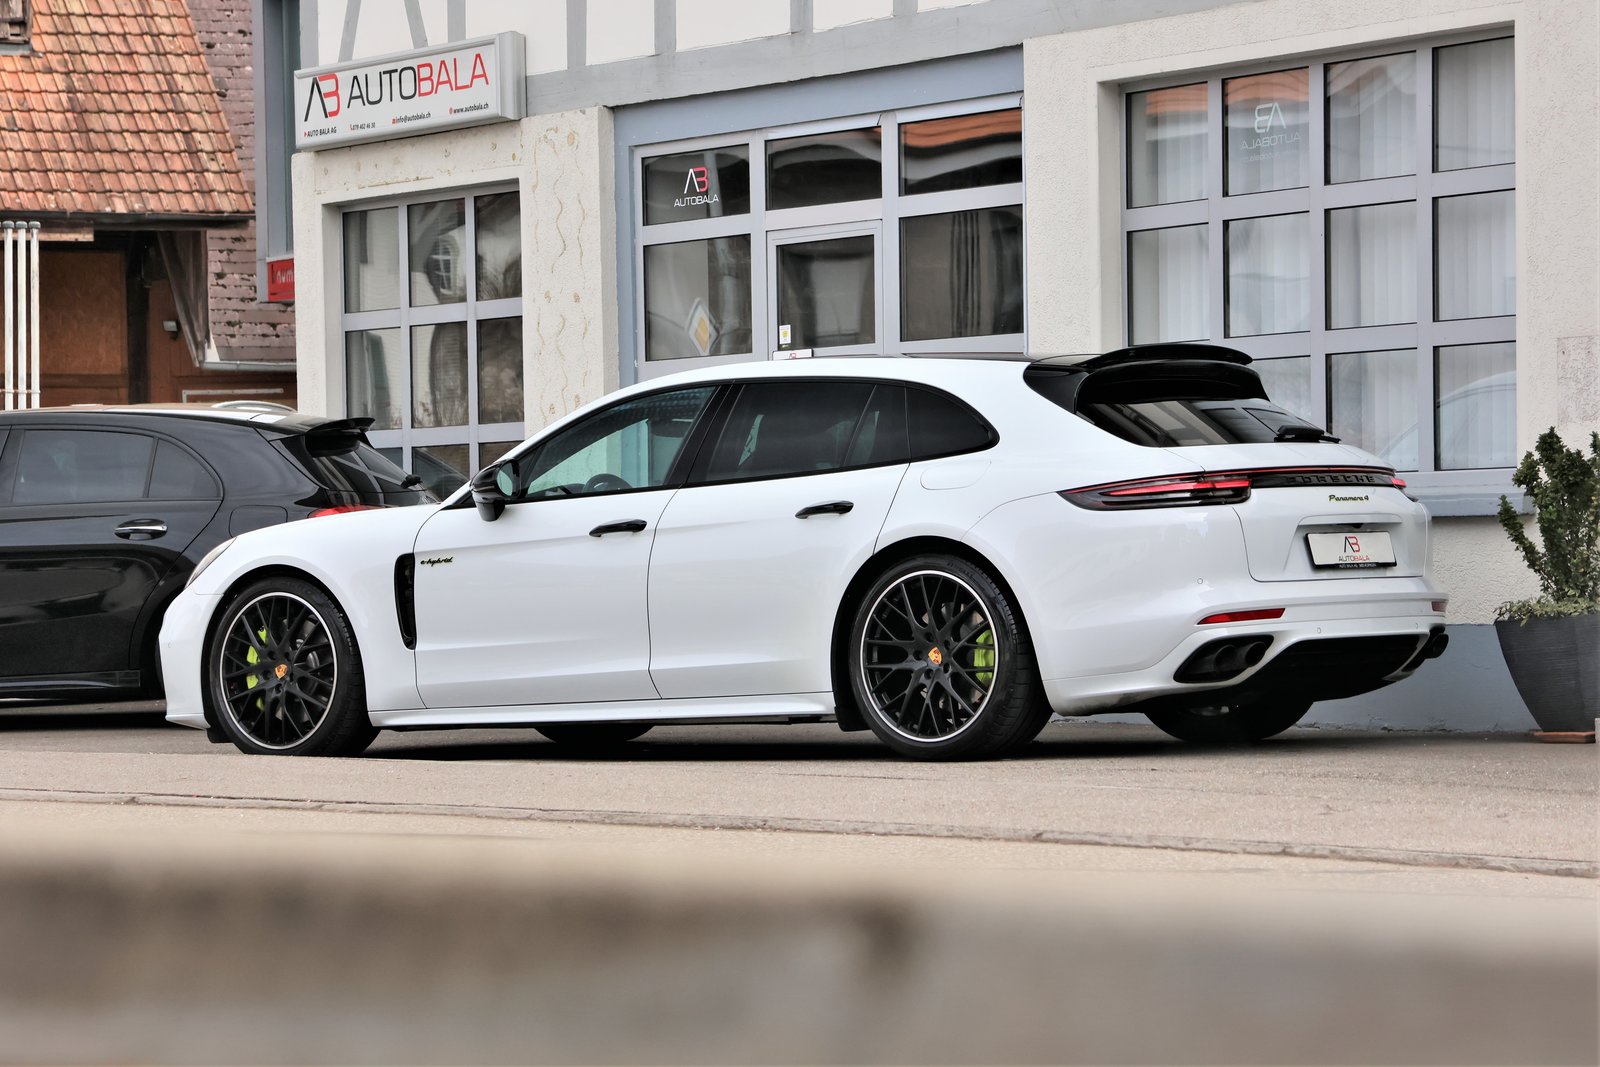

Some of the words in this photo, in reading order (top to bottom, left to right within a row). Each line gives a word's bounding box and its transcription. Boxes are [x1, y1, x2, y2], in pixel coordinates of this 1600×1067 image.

[347, 53, 489, 109] AUTOBALA
[453, 102, 489, 114] www.autobala.ch
[395, 112, 431, 124] info@autobala.ch
[307, 130, 319, 138] AUTO
[319, 128, 330, 136] BALA
[673, 194, 720, 208] AUTOBALA
[1328, 494, 1364, 502] Panamera
